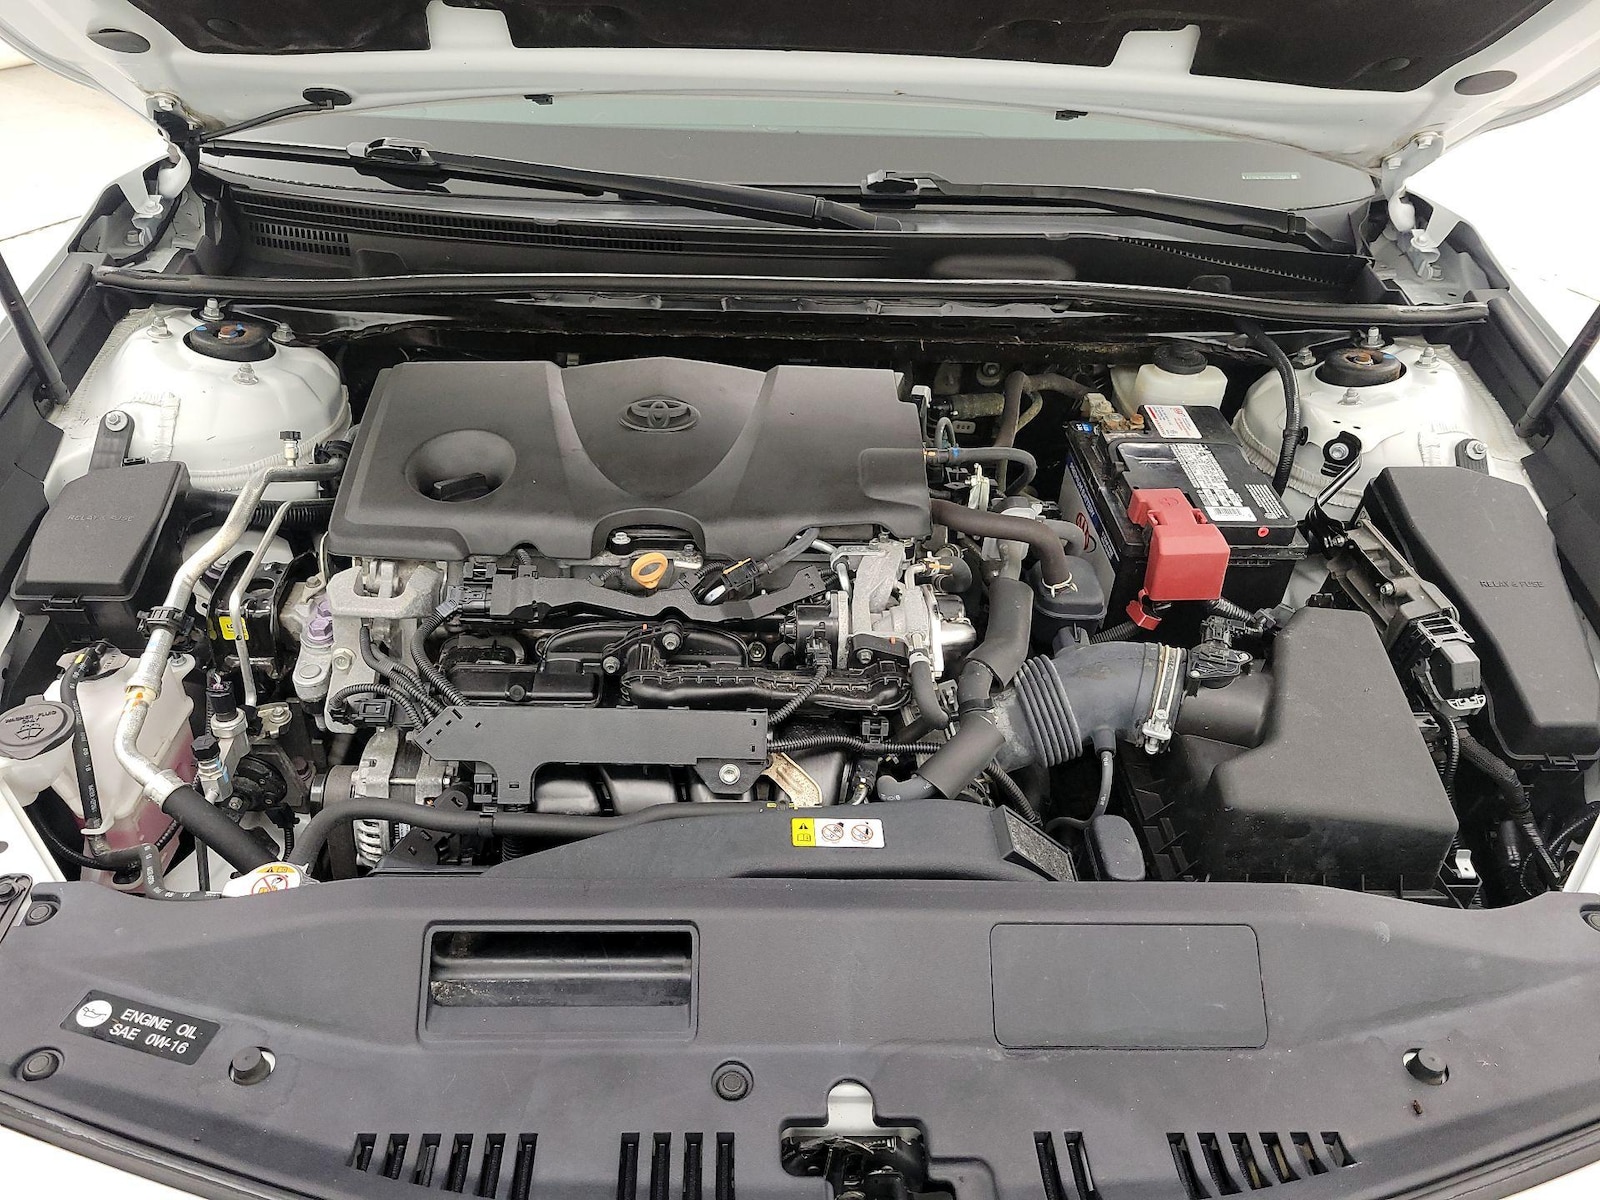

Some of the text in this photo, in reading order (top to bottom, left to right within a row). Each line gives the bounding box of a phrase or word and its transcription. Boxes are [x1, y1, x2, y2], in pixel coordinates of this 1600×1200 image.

[109, 1023, 190, 1055] SAE 0W-16
[120, 1008, 199, 1040] ENGINE OIL
